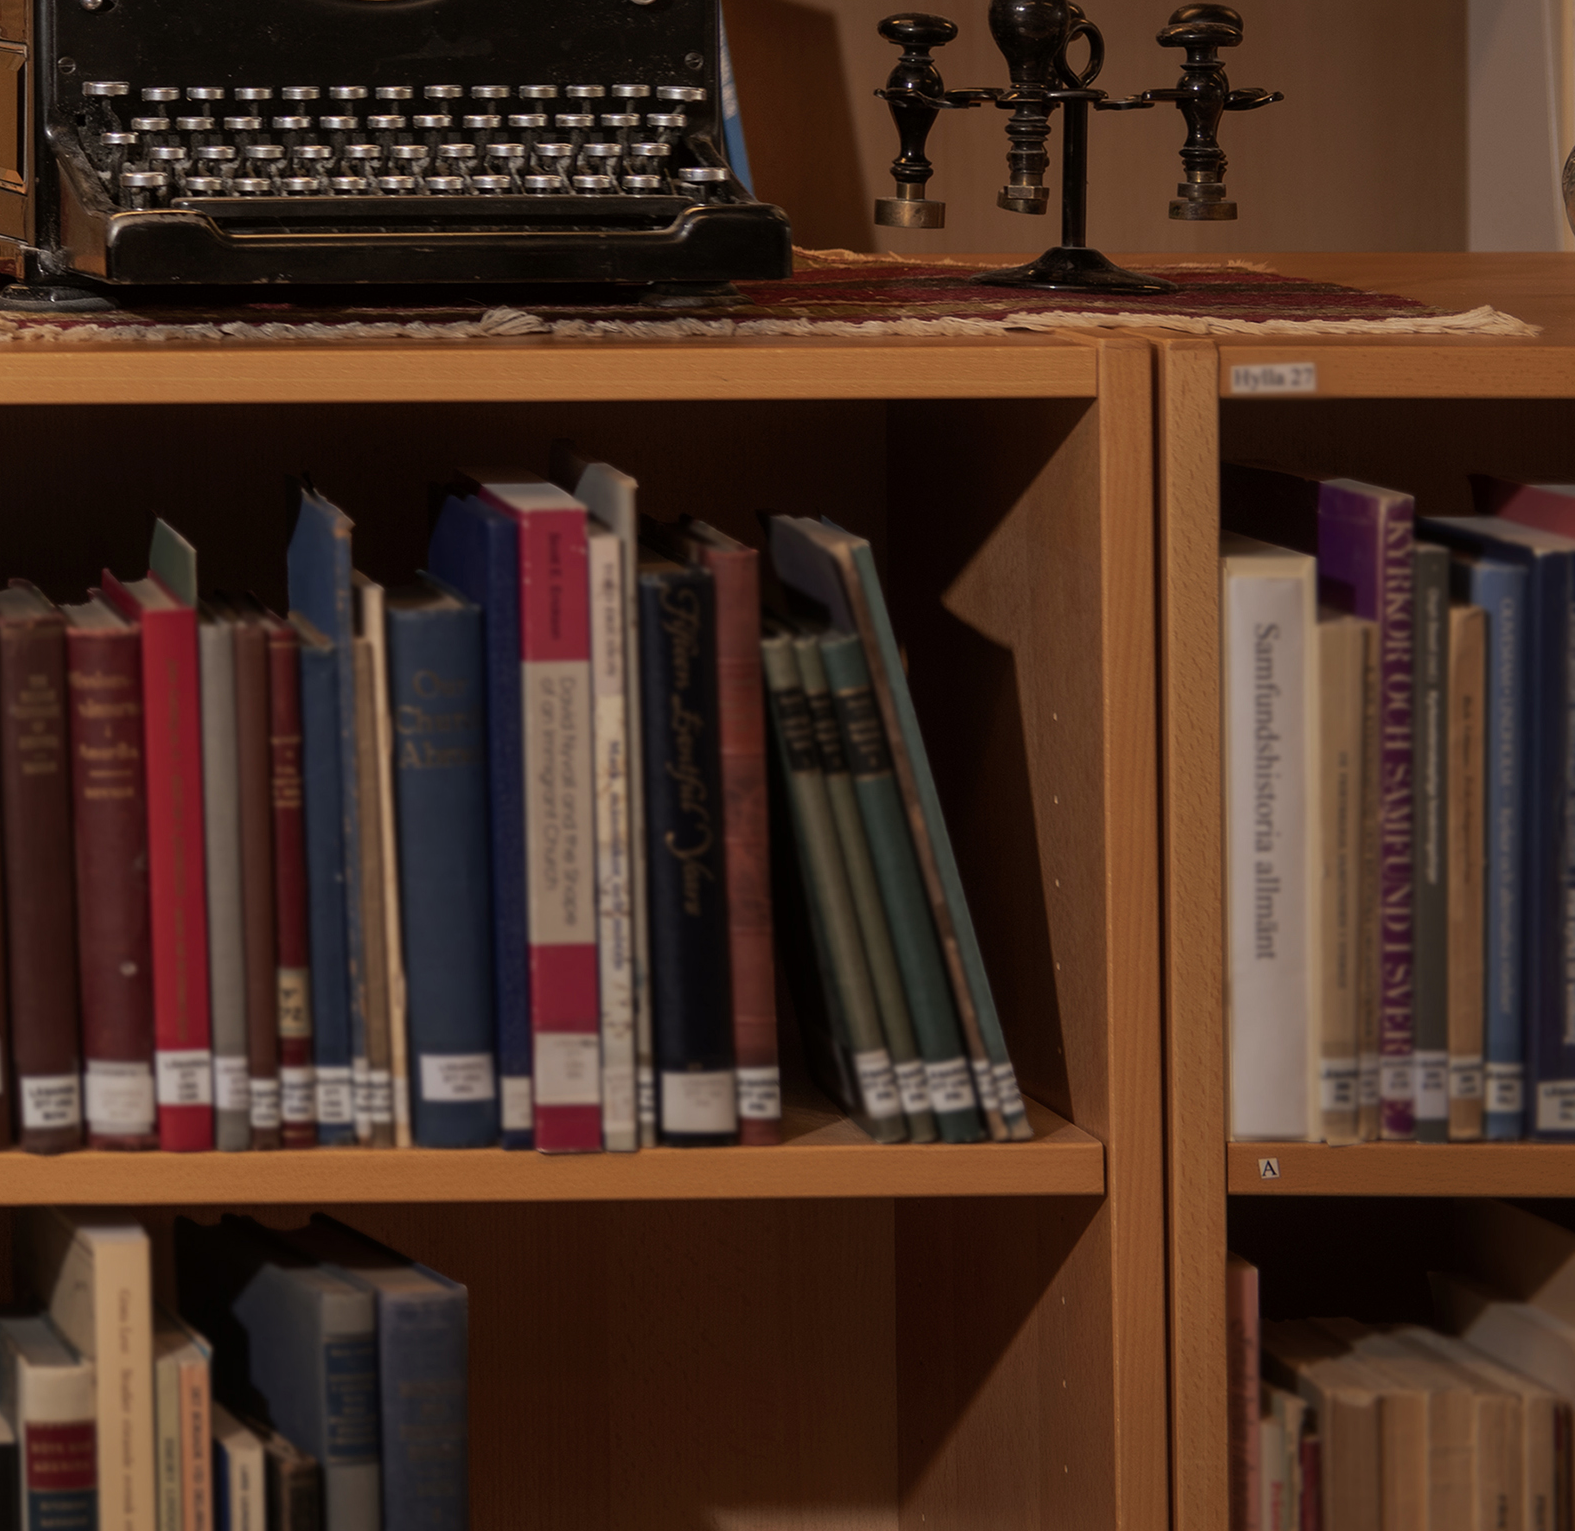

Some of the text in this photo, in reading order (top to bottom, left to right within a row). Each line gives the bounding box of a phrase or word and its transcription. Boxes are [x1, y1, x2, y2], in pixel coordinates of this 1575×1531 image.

[1233, 366, 1314, 391] Hylla 27
[1382, 519, 1413, 662] KYRKOR
[1382, 671, 1413, 750] OCH
[537, 677, 560, 891] of an Immigrant Church
[554, 677, 580, 926] David Nyvall and the Shape
[1254, 622, 1282, 960] Samfundshistoria allmänt
[1382, 761, 1413, 932] SAMFUND
[1382, 961, 1413, 1058] SVER
[1261, 1159, 1279, 1177] A
